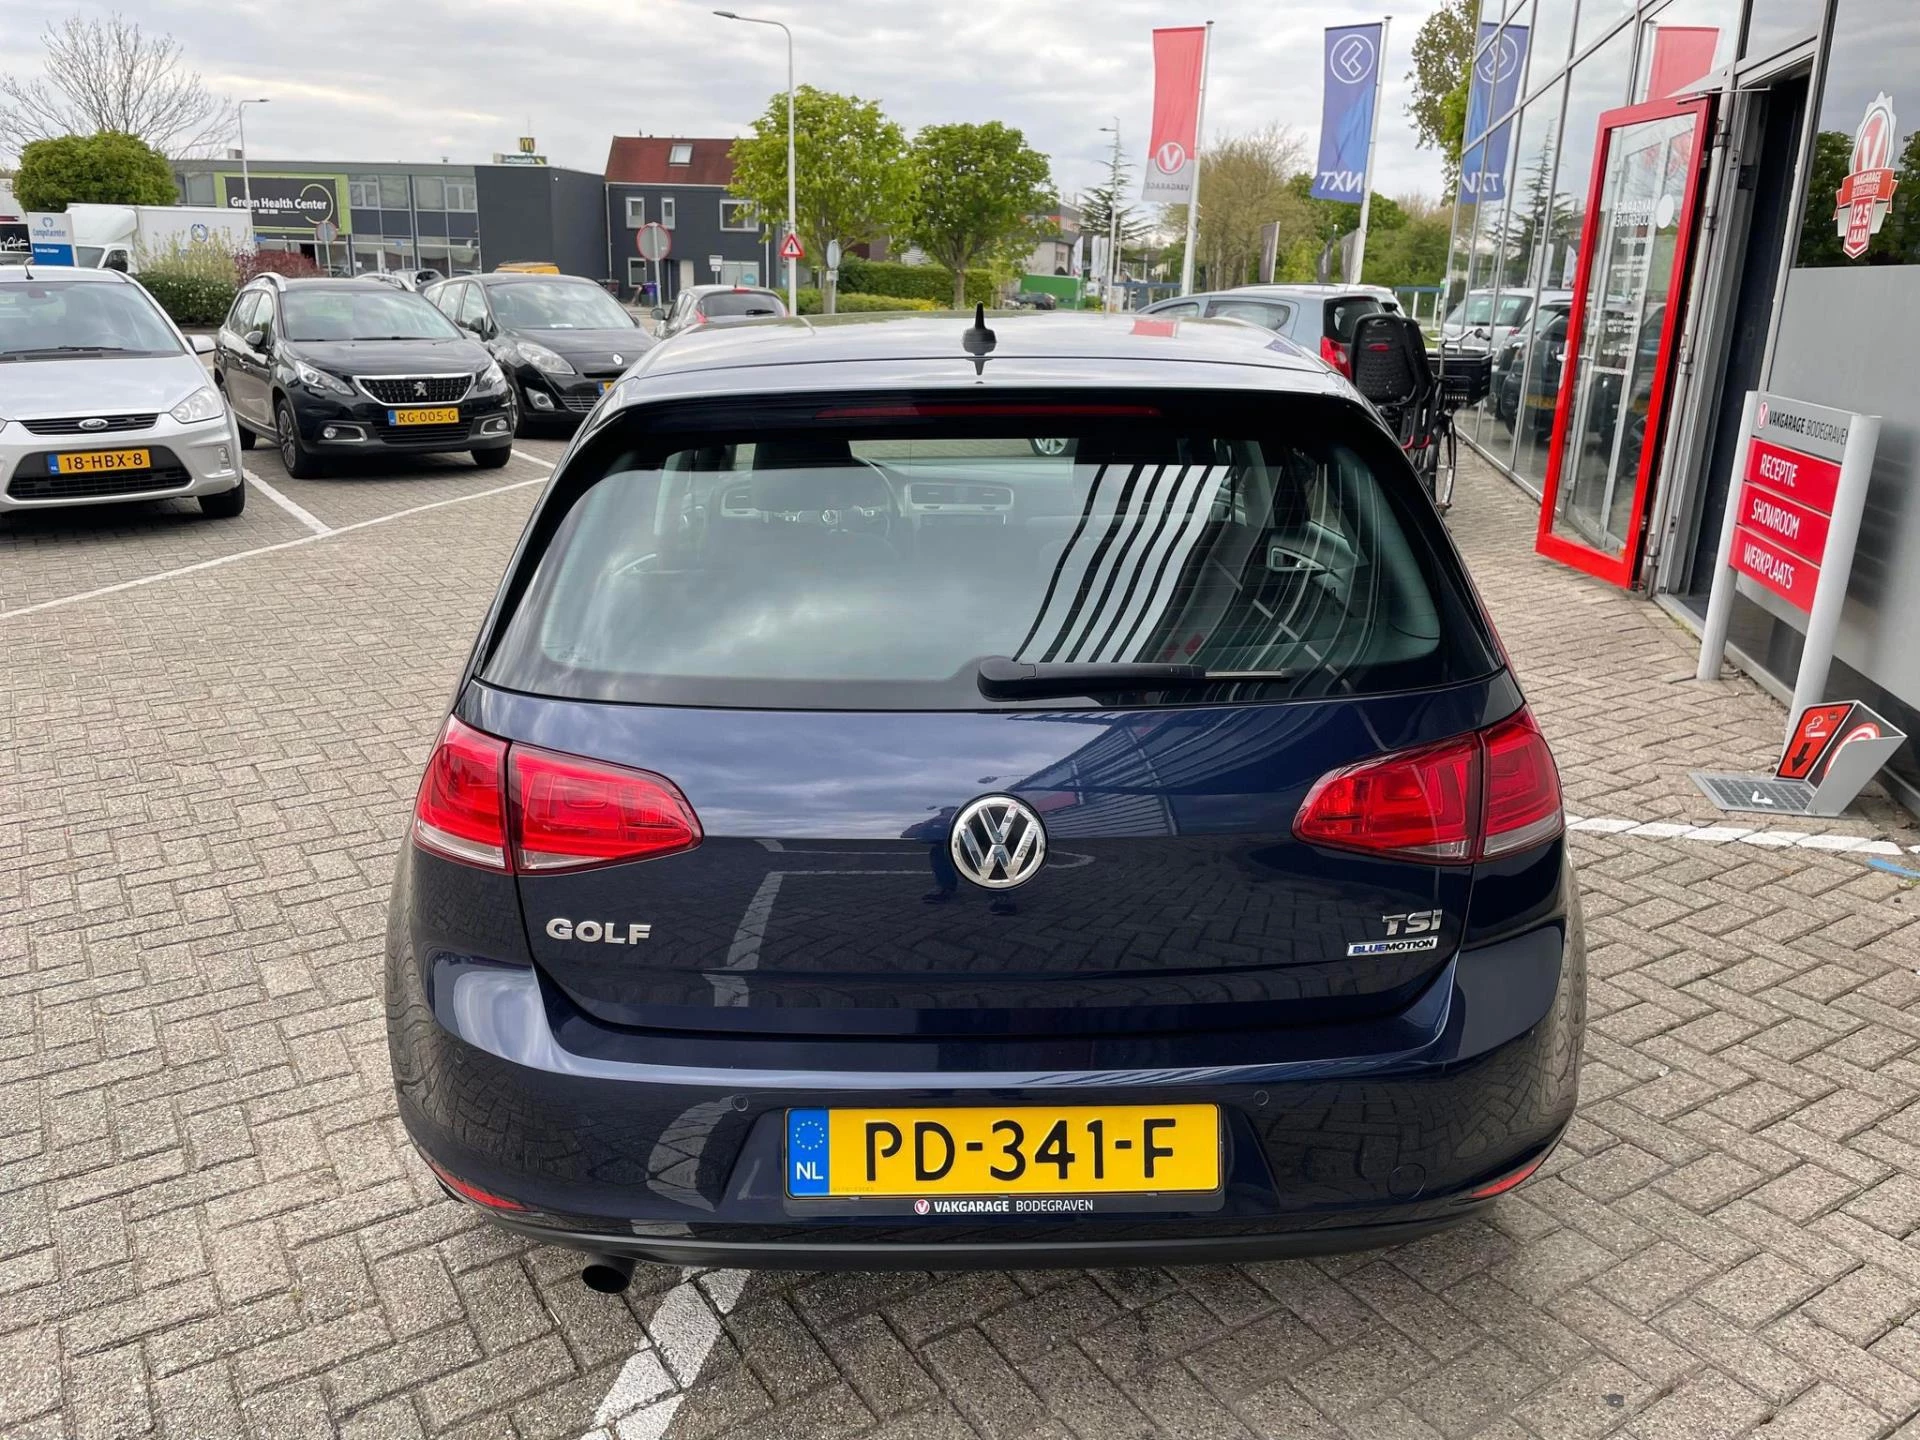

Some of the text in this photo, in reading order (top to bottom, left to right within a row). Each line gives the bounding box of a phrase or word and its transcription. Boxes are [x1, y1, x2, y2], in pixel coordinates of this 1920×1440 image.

[231, 197, 327, 210] Green Health Center
[398, 410, 456, 423] RG-005-G
[1769, 410, 1805, 433] VAKGARAGE
[66, 453, 142, 470] 18-HBX-8
[1760, 454, 1798, 487] RECEPTIE
[1751, 498, 1800, 540] SHOWROOM
[1743, 542, 1795, 590] WERKPLAATS
[546, 918, 652, 945] GOLF
[1382, 909, 1443, 936] TSI
[1353, 939, 1434, 954] BLUEMOTION
[796, 1118, 1176, 1181] NL PD-341-F
[934, 1199, 1009, 1213] VAKGARAGE
[1016, 1200, 1094, 1212] BODEGRAVEN
